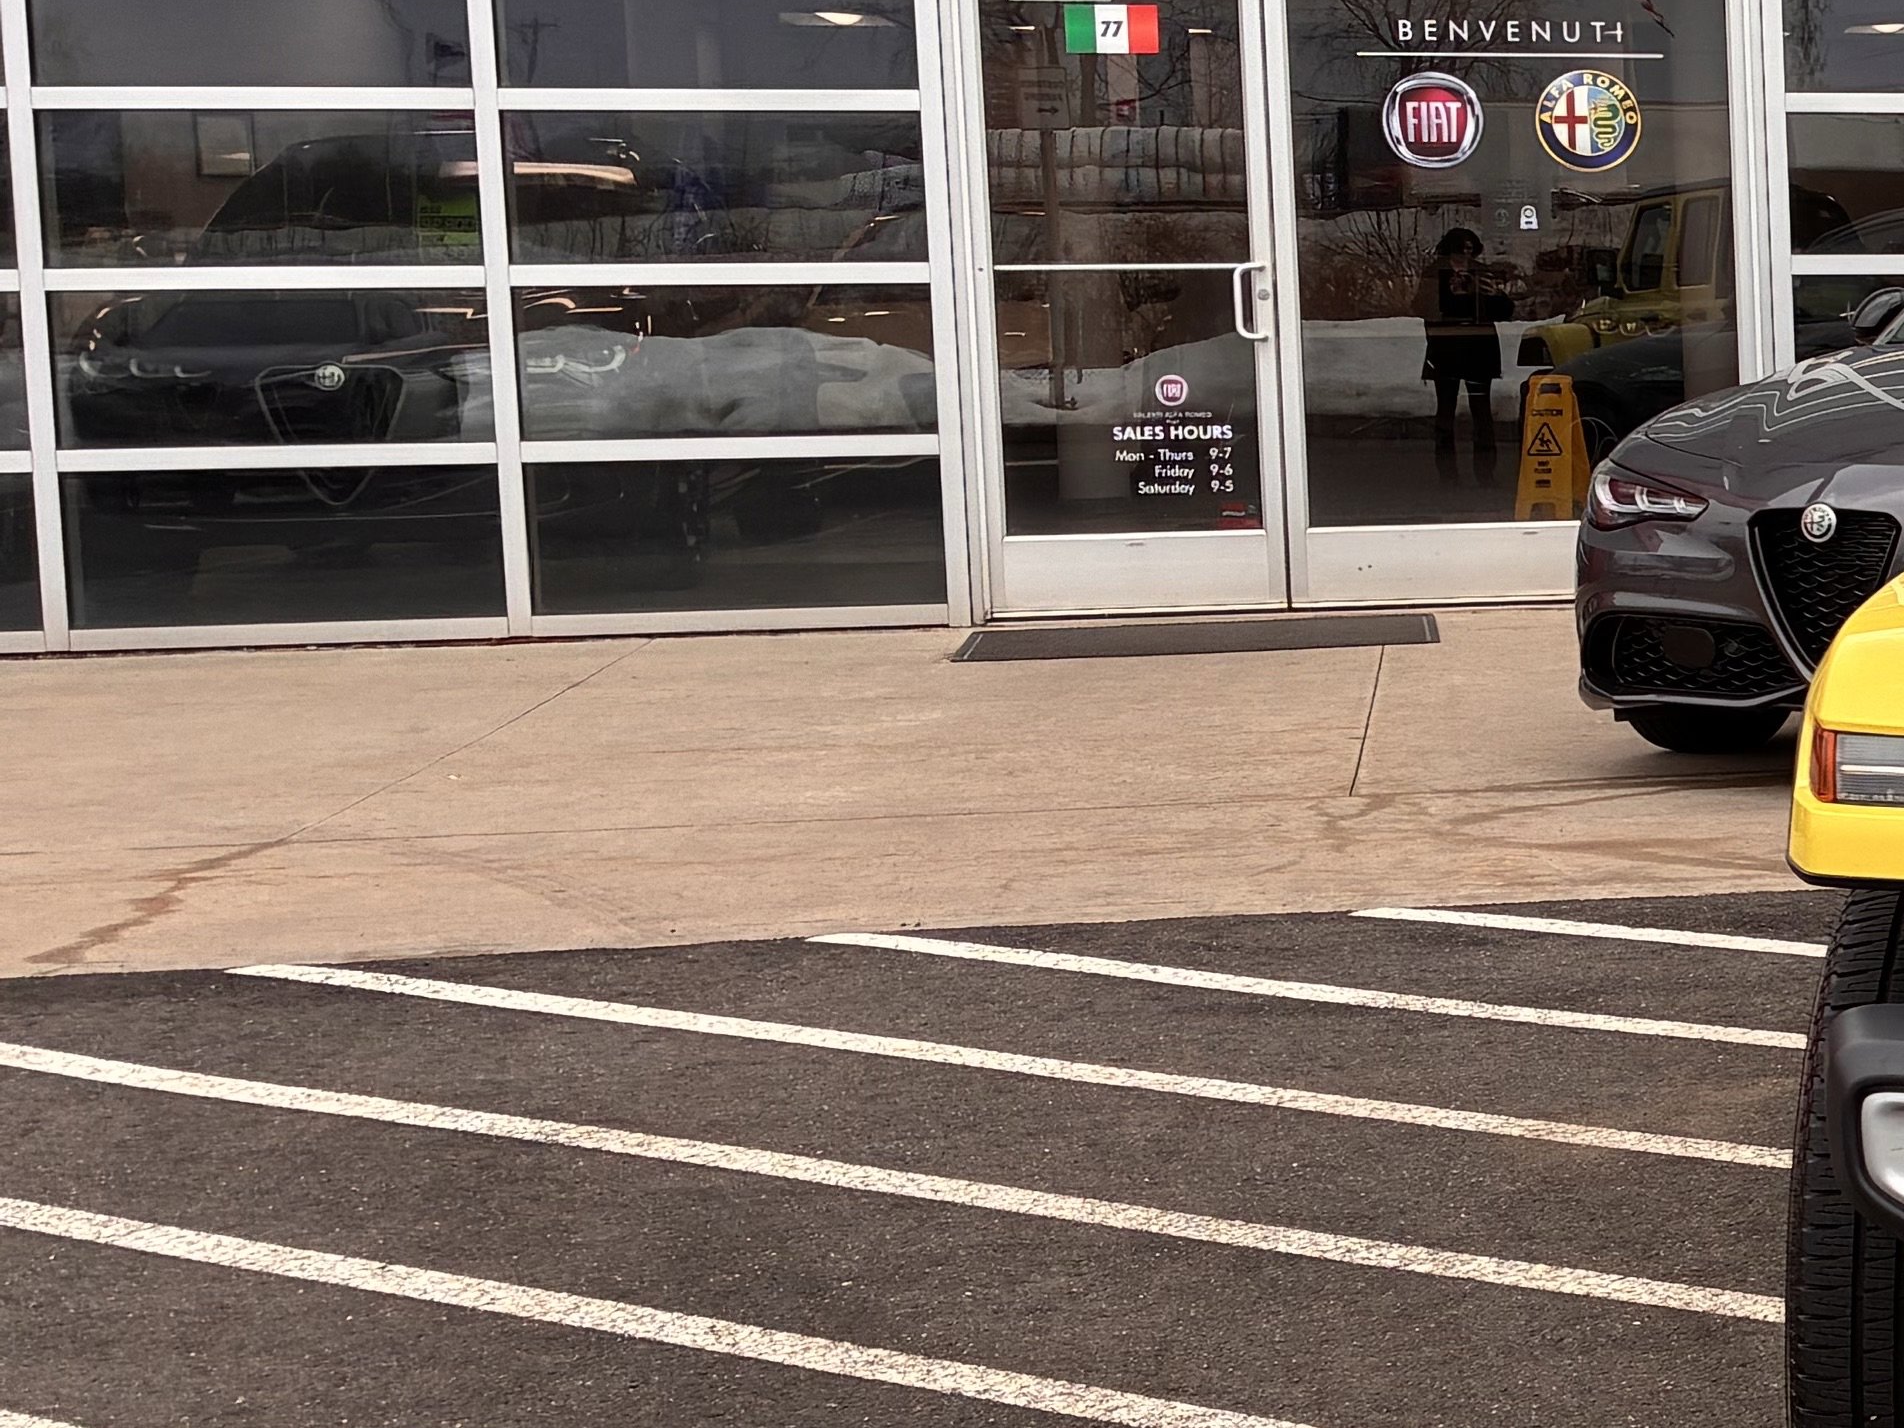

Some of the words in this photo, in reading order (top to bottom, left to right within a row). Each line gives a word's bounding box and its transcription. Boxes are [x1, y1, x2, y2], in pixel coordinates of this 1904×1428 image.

[1101, 21, 1124, 37] 77
[1539, 79, 1574, 124] ALFA
[1583, 73, 1638, 125] ROMEO
[1405, 101, 1462, 143] FIAT
[1113, 425, 1164, 440] SALES
[1170, 425, 1233, 440] HOURS
[1115, 450, 1145, 461] Mon
[1157, 449, 1194, 461] Thurs
[1209, 447, 1232, 459] 9-7
[1154, 465, 1195, 478] Friday
[1210, 464, 1233, 476] 9-6
[1138, 481, 1195, 495] Saturday
[1210, 480, 1234, 492] 9-5
